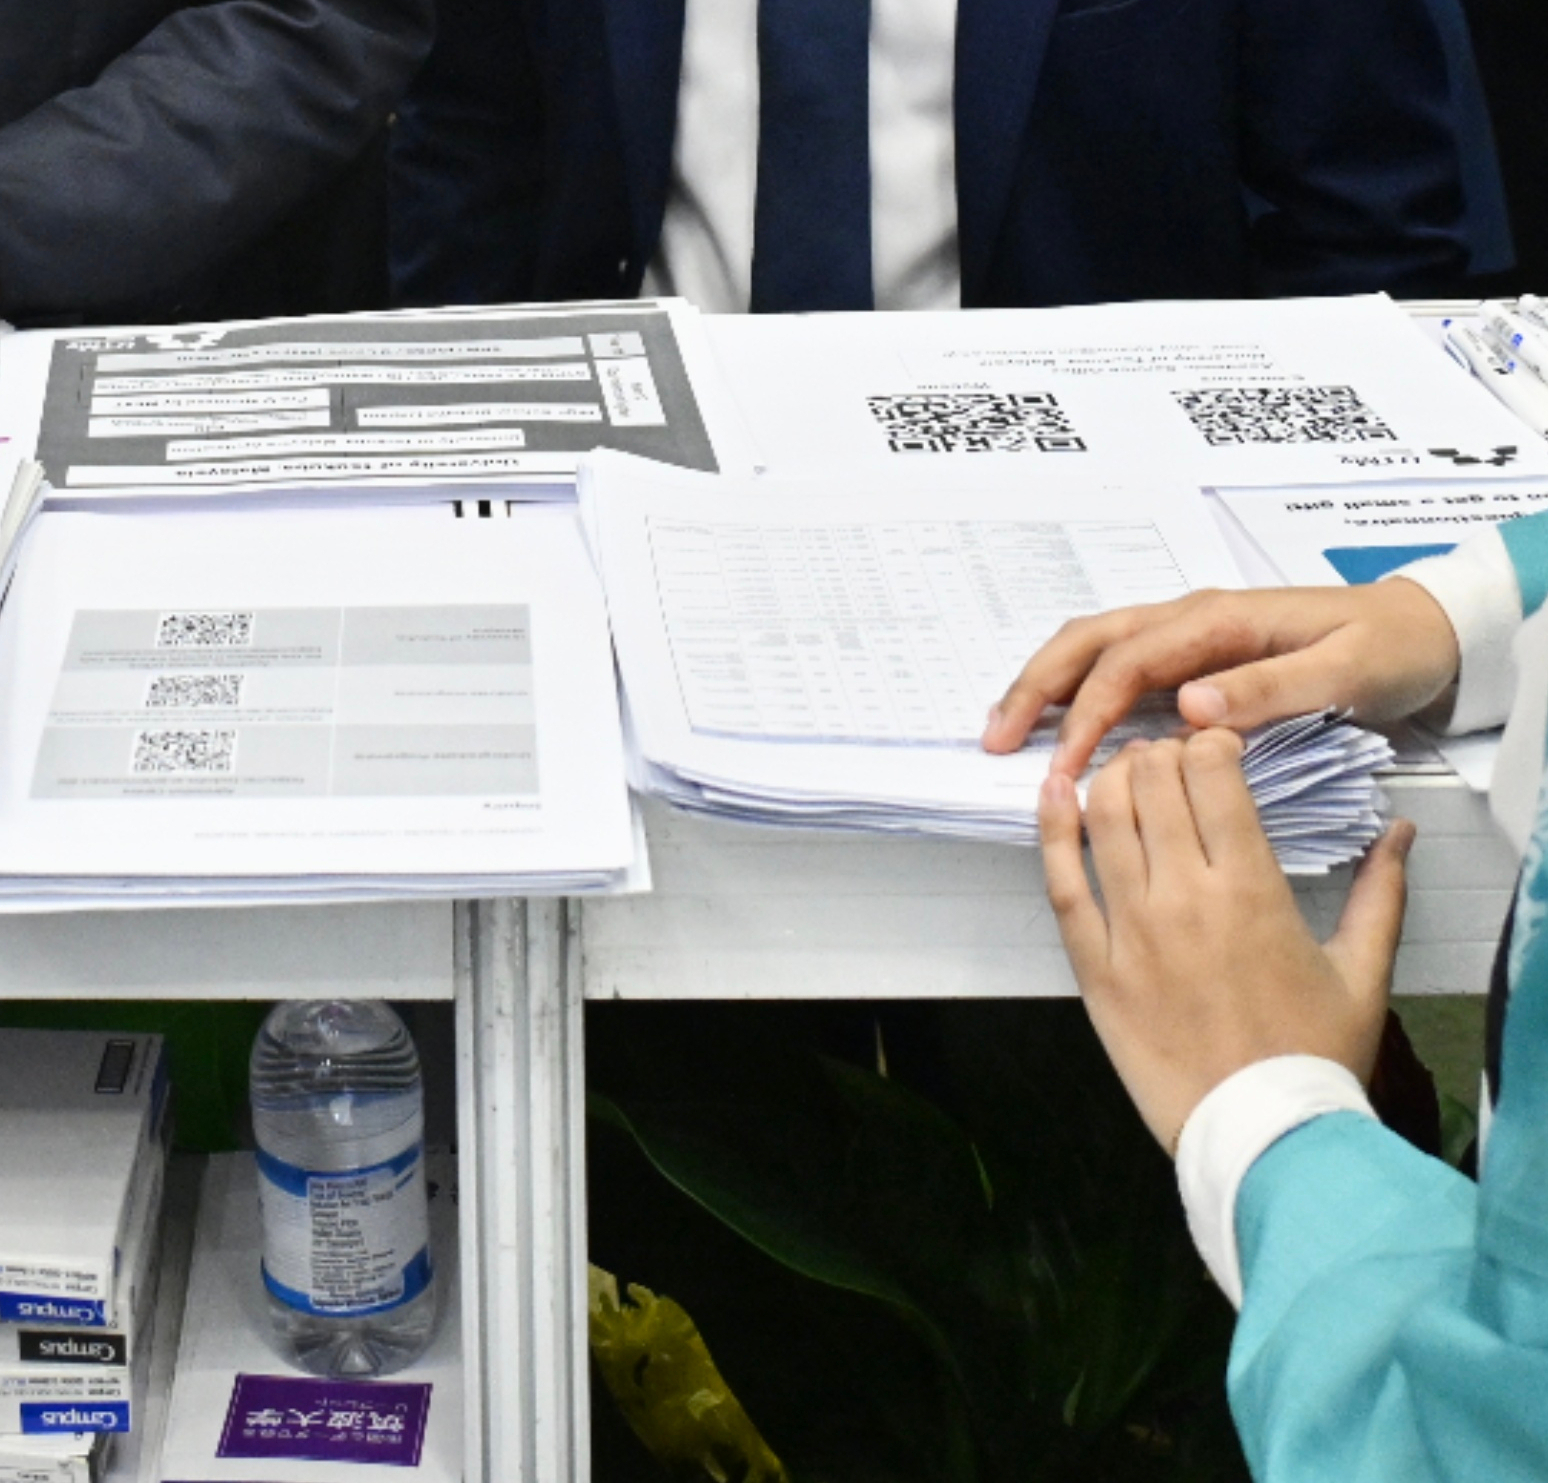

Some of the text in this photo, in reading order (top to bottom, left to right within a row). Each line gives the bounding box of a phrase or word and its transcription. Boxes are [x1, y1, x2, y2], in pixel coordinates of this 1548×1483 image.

[17, 1301, 95, 1322] Campus
[39, 1338, 116, 1362] Campus
[41, 1408, 119, 1429] Campus
[245, 1408, 405, 1432] 筑波大学
